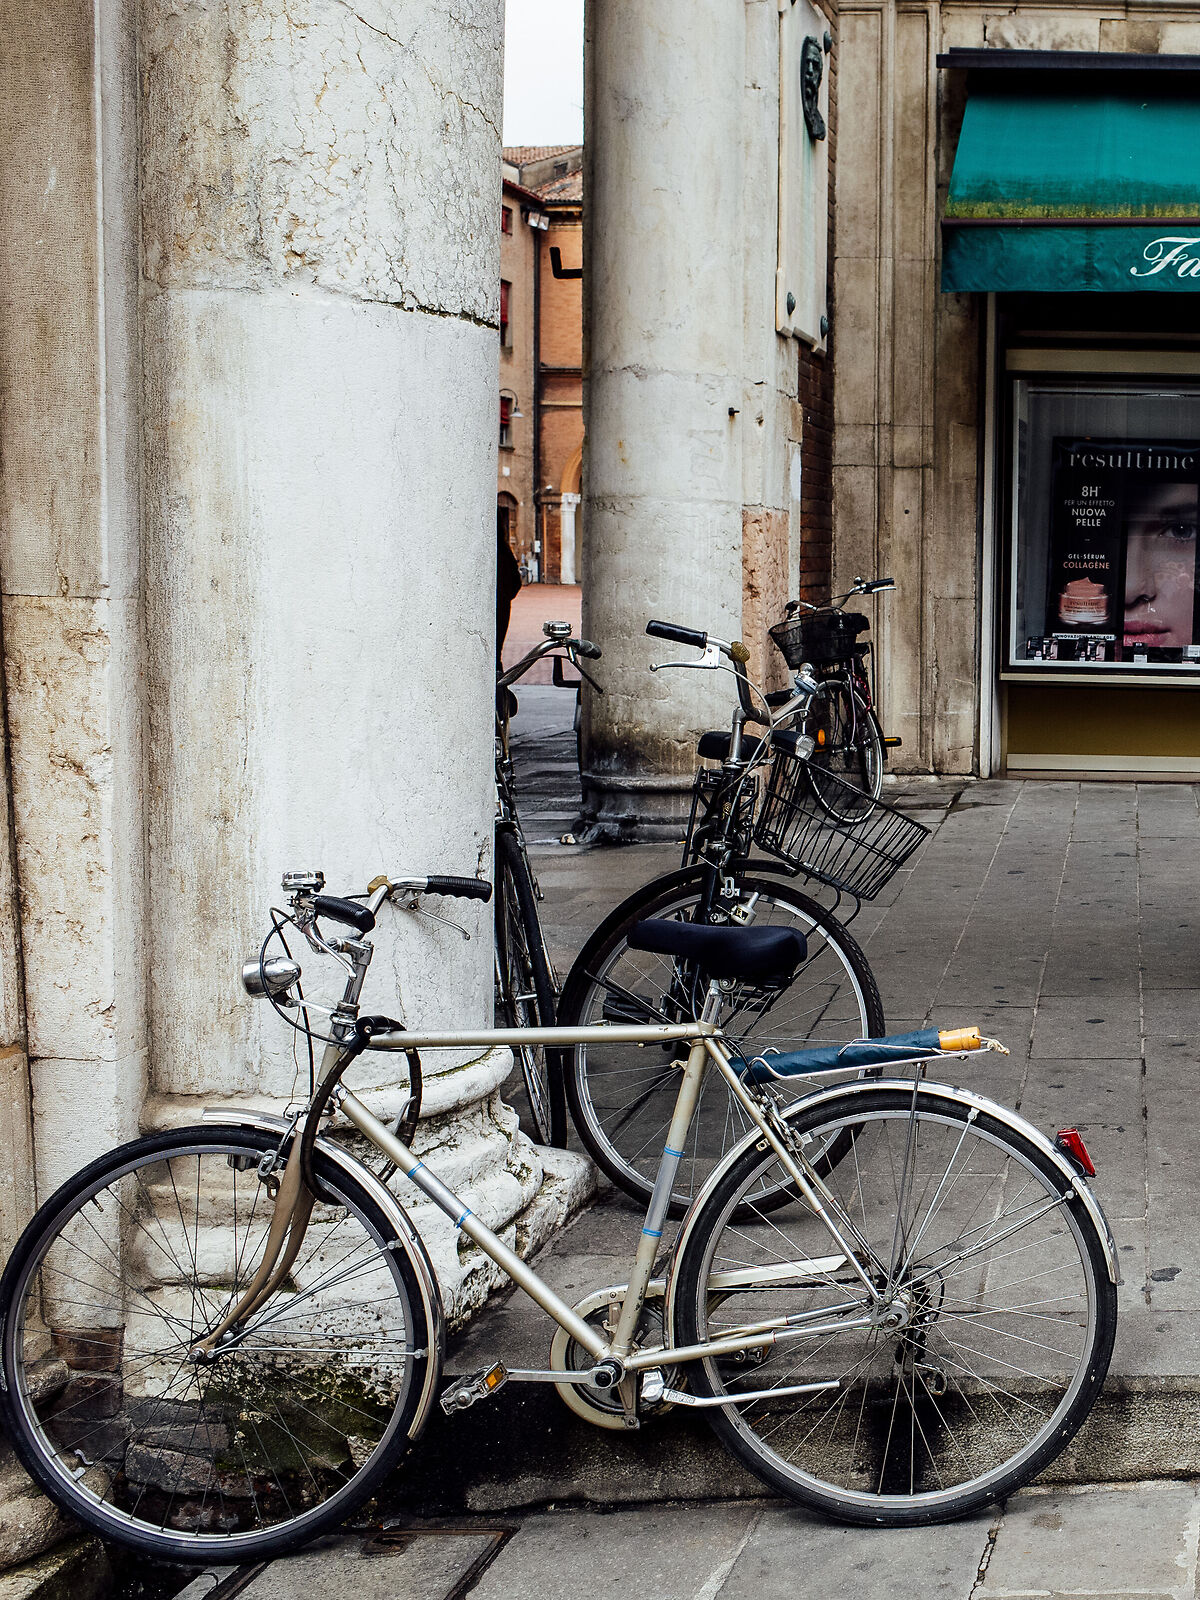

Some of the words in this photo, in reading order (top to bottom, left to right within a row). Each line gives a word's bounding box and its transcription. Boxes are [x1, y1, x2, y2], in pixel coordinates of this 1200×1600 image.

[1070, 448, 1194, 470] resultime
[1071, 508, 1107, 517] NUOVA
[1076, 518, 1101, 527] PELLE
